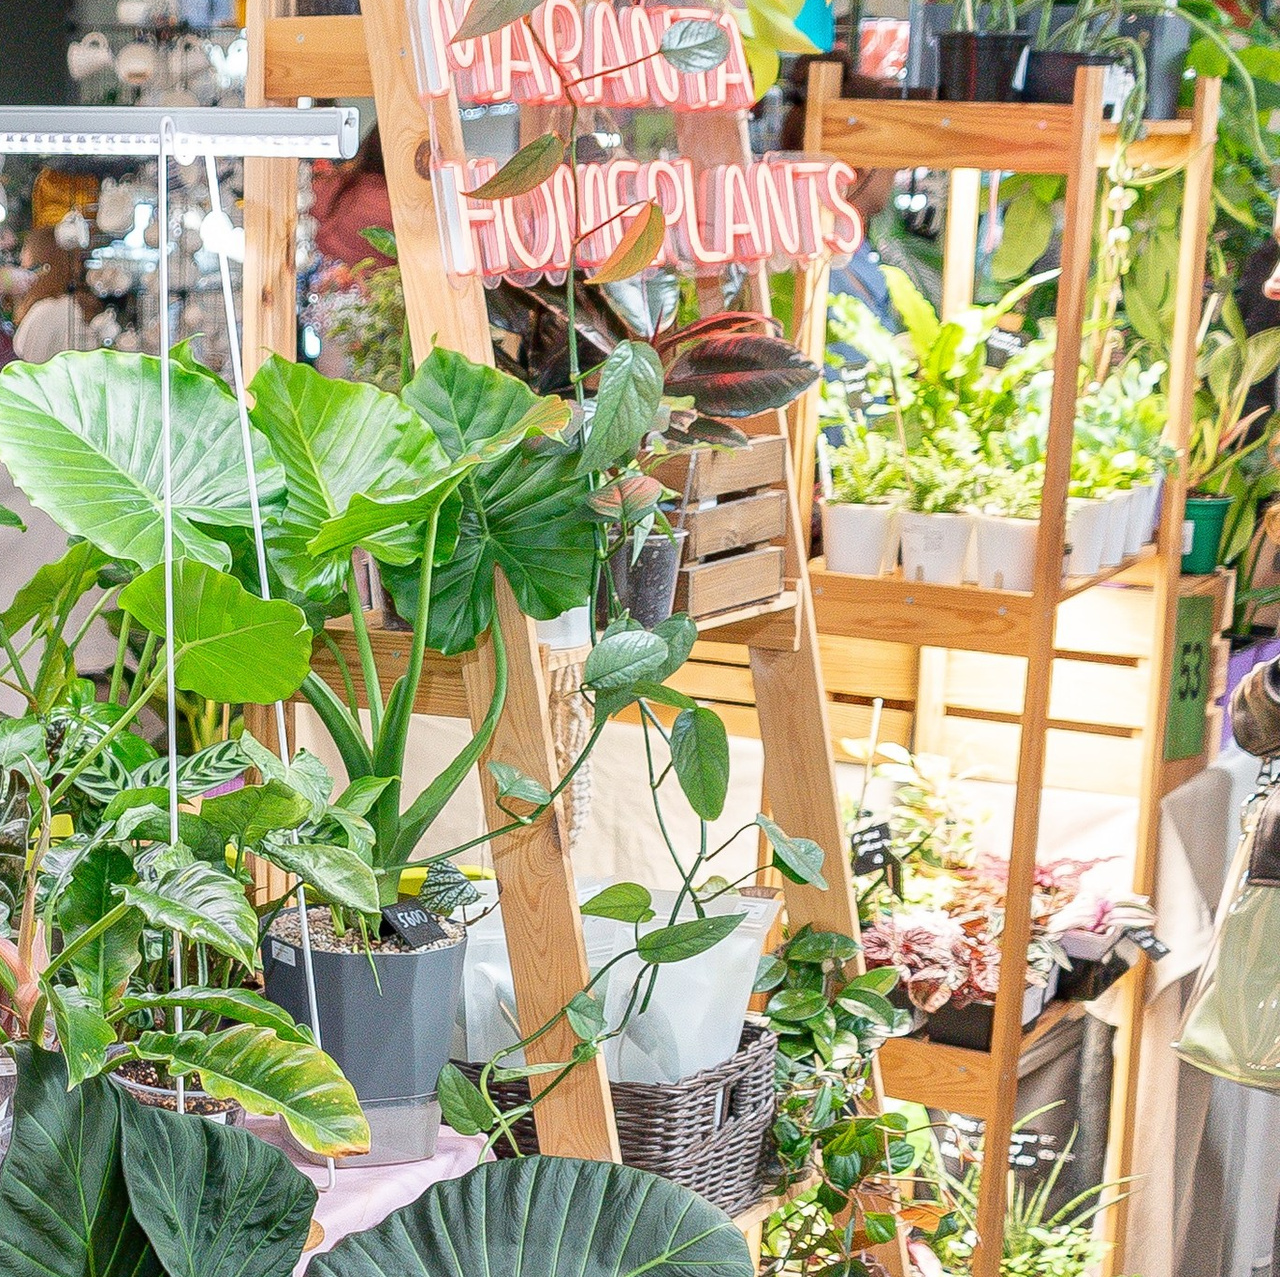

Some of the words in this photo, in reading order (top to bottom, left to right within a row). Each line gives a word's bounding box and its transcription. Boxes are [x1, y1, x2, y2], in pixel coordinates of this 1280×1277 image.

[436, 158, 866, 275] HOMEPLANTS
[1179, 641, 1203, 701] 53
[397, 909, 429, 929] 5600
